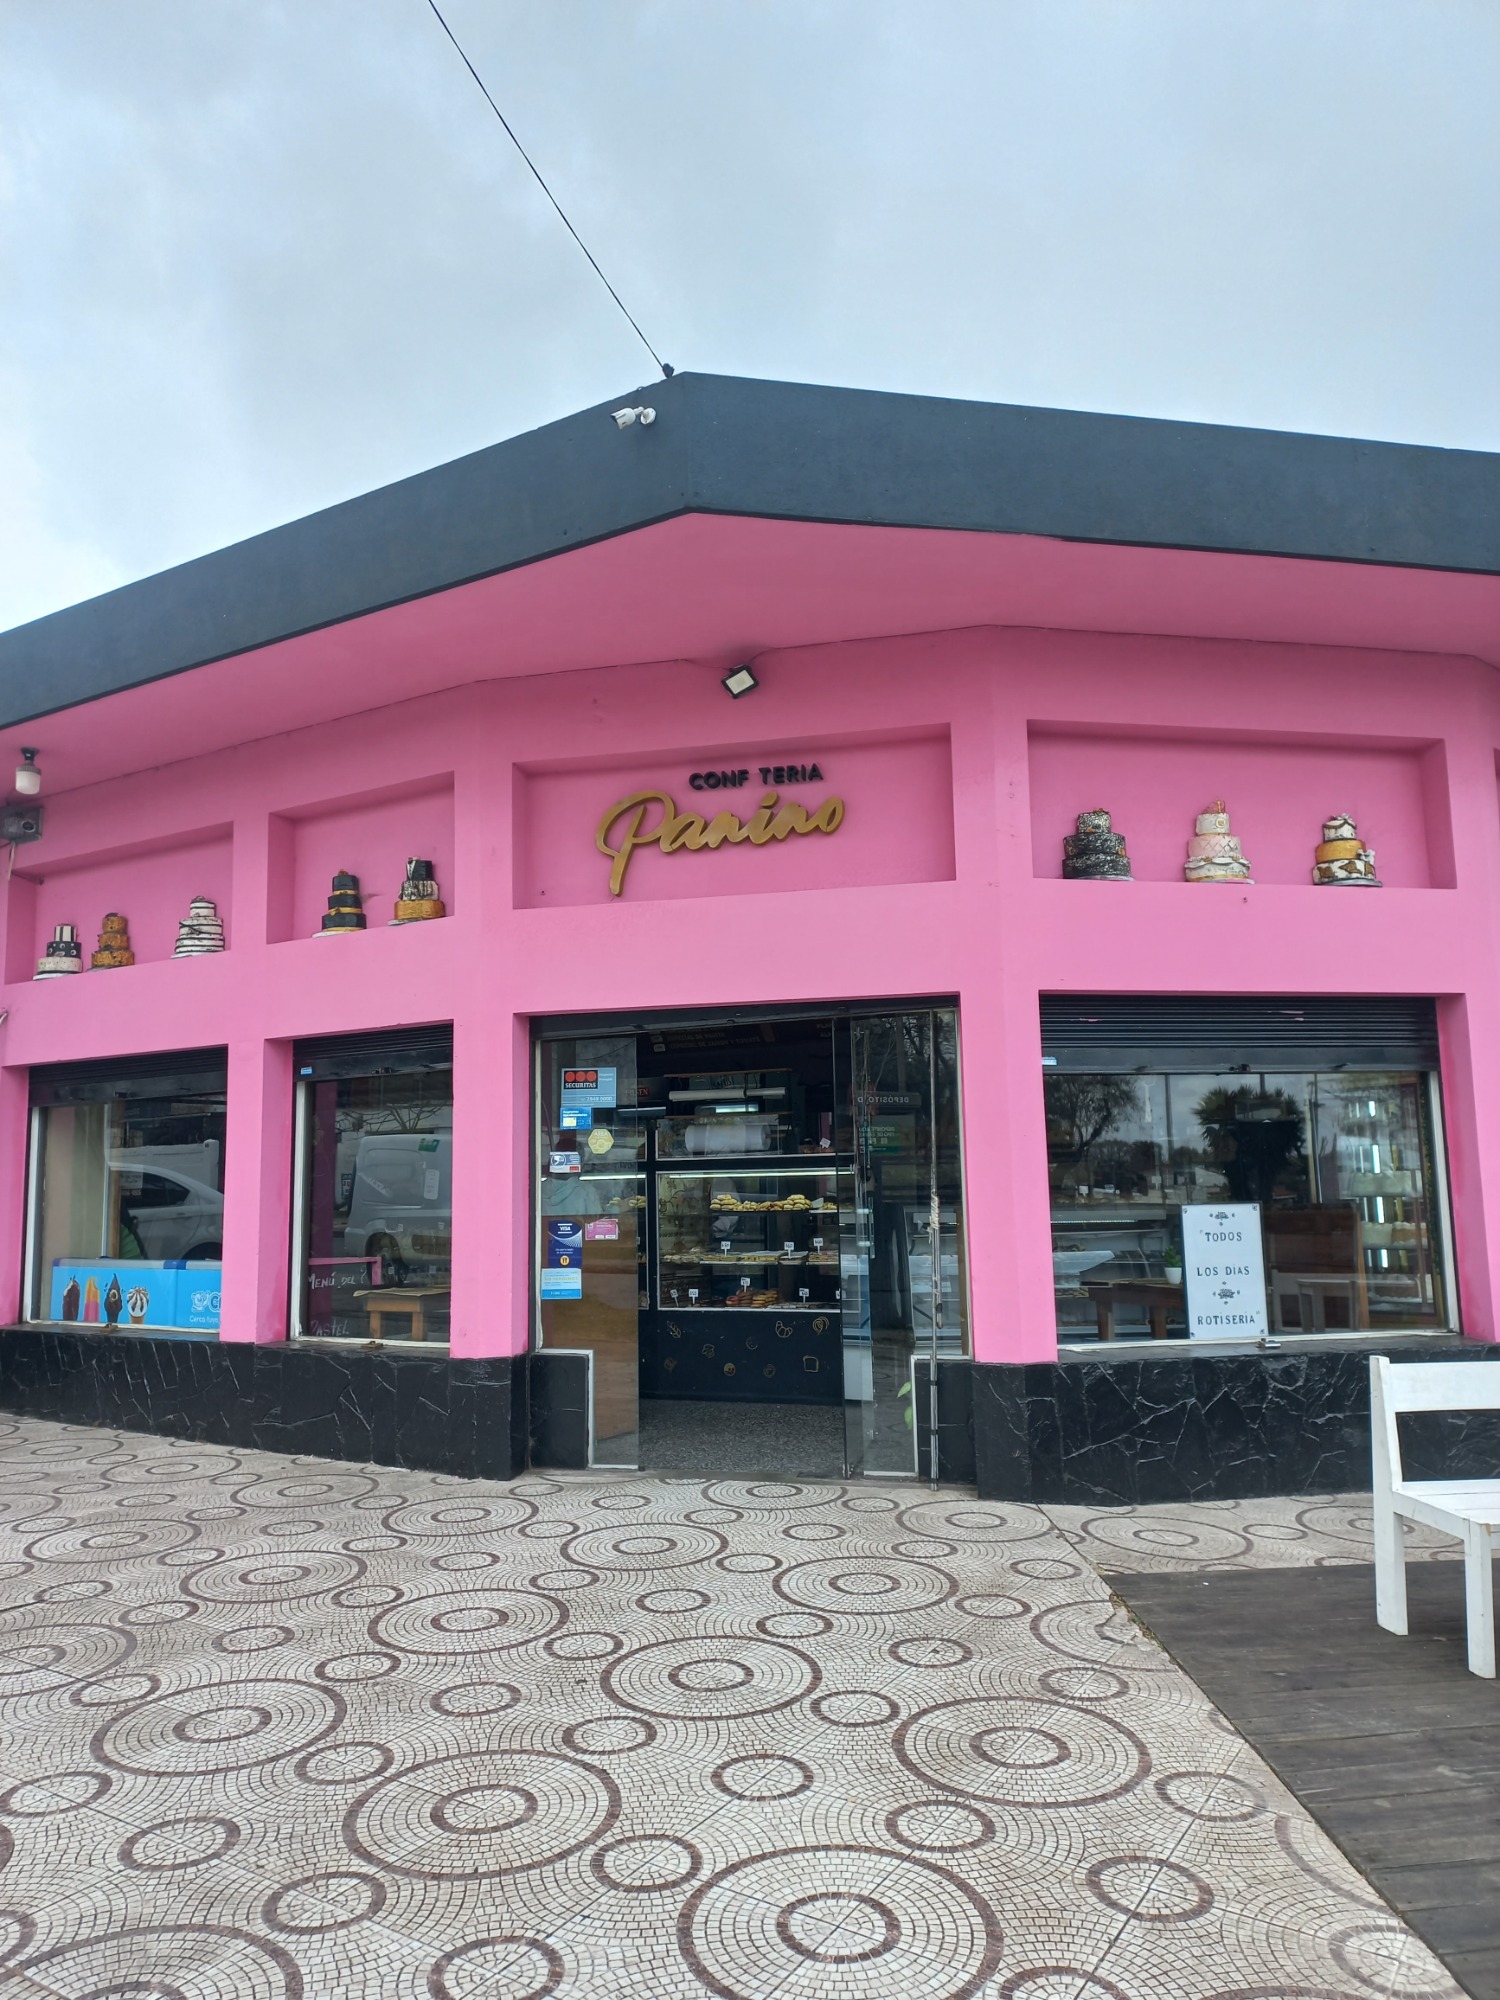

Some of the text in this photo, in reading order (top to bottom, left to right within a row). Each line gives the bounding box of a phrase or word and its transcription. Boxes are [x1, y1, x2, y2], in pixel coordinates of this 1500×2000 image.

[689, 763, 824, 791] CONF TERIA
[595, 789, 845, 897] Panino
[1196, 1266, 1219, 1277] LOS
